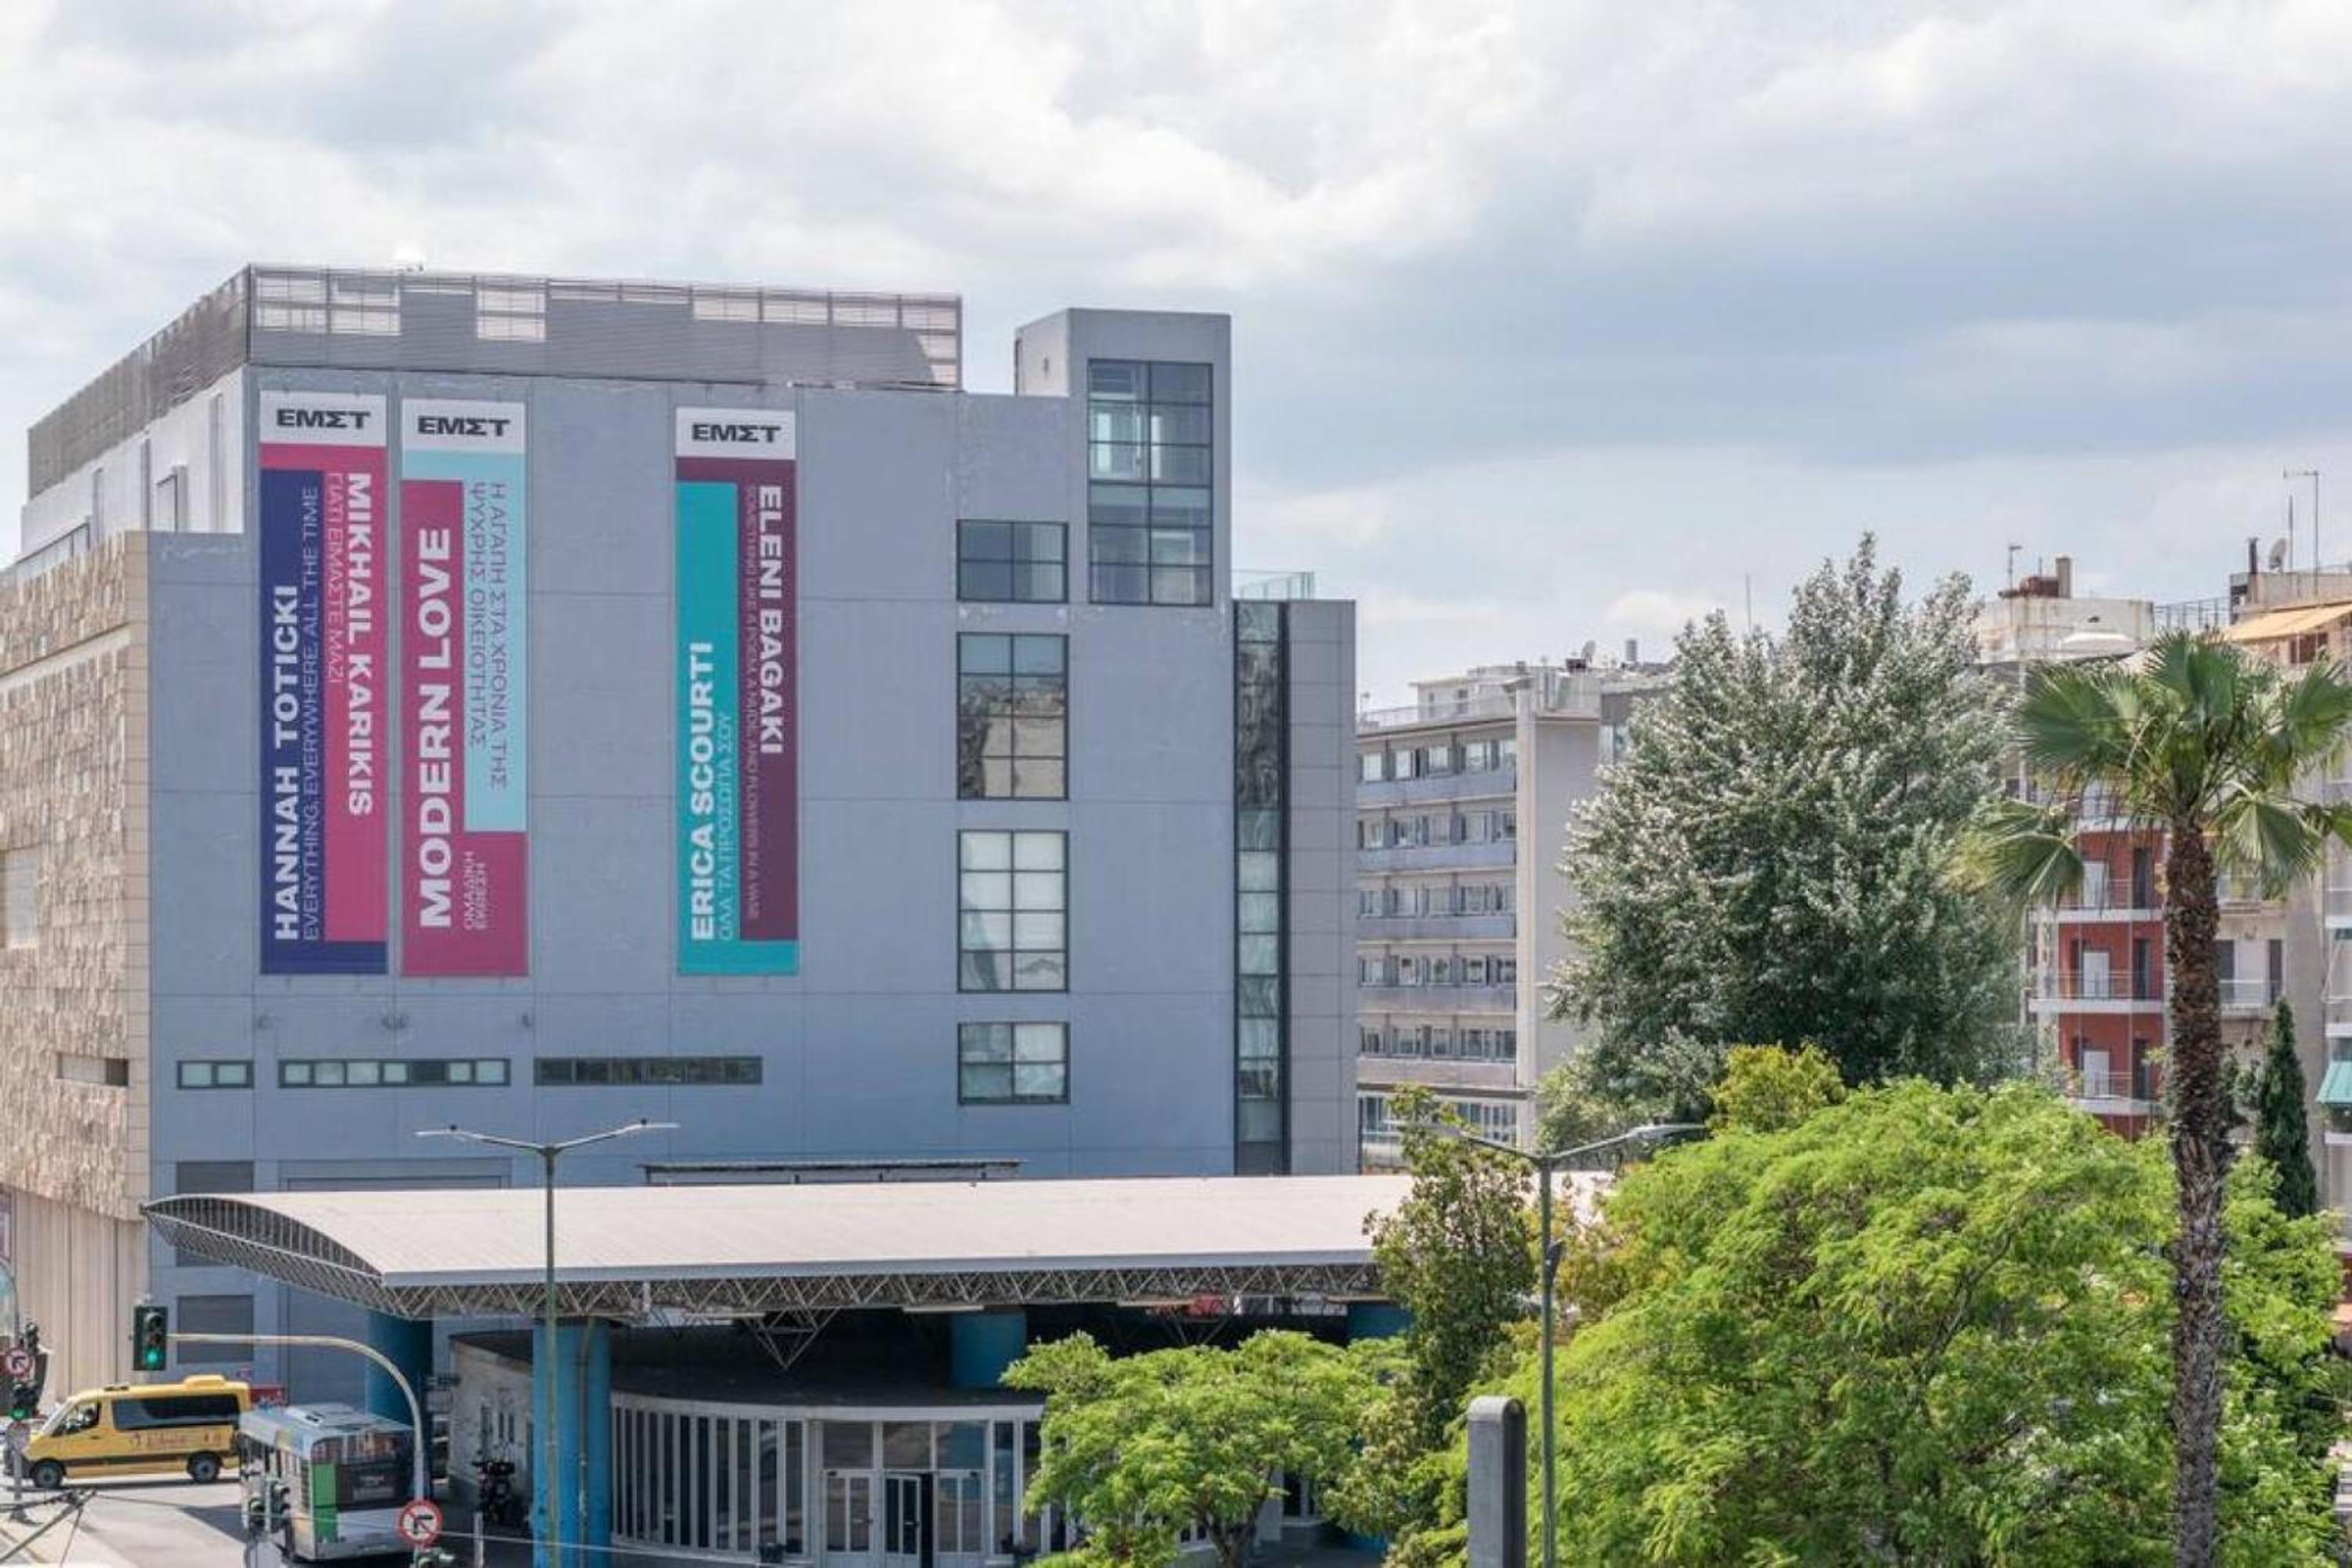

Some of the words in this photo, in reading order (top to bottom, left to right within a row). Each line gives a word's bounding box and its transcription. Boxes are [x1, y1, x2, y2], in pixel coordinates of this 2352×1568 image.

[277, 408, 371, 430] ΕΜΣΤ
[418, 416, 510, 436] ΕΜΣΤ
[692, 424, 782, 443] ΕΜΣΤ
[302, 487, 318, 543] TIME
[328, 471, 344, 522] ΓΙΑΤΙ
[470, 481, 487, 583] ΨΥΧΡΗΣ
[491, 506, 506, 584] ΑΓΑΠΗ
[760, 485, 782, 598] ELENI
[302, 547, 318, 590] THE
[328, 527, 344, 624] ΕΙΜΑΣΤΕ
[347, 473, 372, 644] MIKHAIL
[418, 528, 451, 668] LOVE
[302, 596, 318, 638] ALL
[328, 629, 344, 684] ΜΑΖΙ
[491, 590, 506, 636] ΣΤΑ
[274, 586, 298, 749] TOTICKI
[470, 589, 487, 749] ΟΙΚΕΙΟΤΗΤΑΣ
[491, 642, 507, 734] ΧΡΟΝΙΑ
[760, 608, 783, 754] BAGAKI
[348, 654, 373, 816] KARIKIS
[491, 740, 507, 790] ΤΗΣ
[689, 641, 713, 815] SCOURTI
[274, 768, 299, 940] HANNAH
[419, 684, 452, 927] MODERN
[303, 800, 319, 941] EVERYTHING,
[691, 824, 713, 941] ERICA
